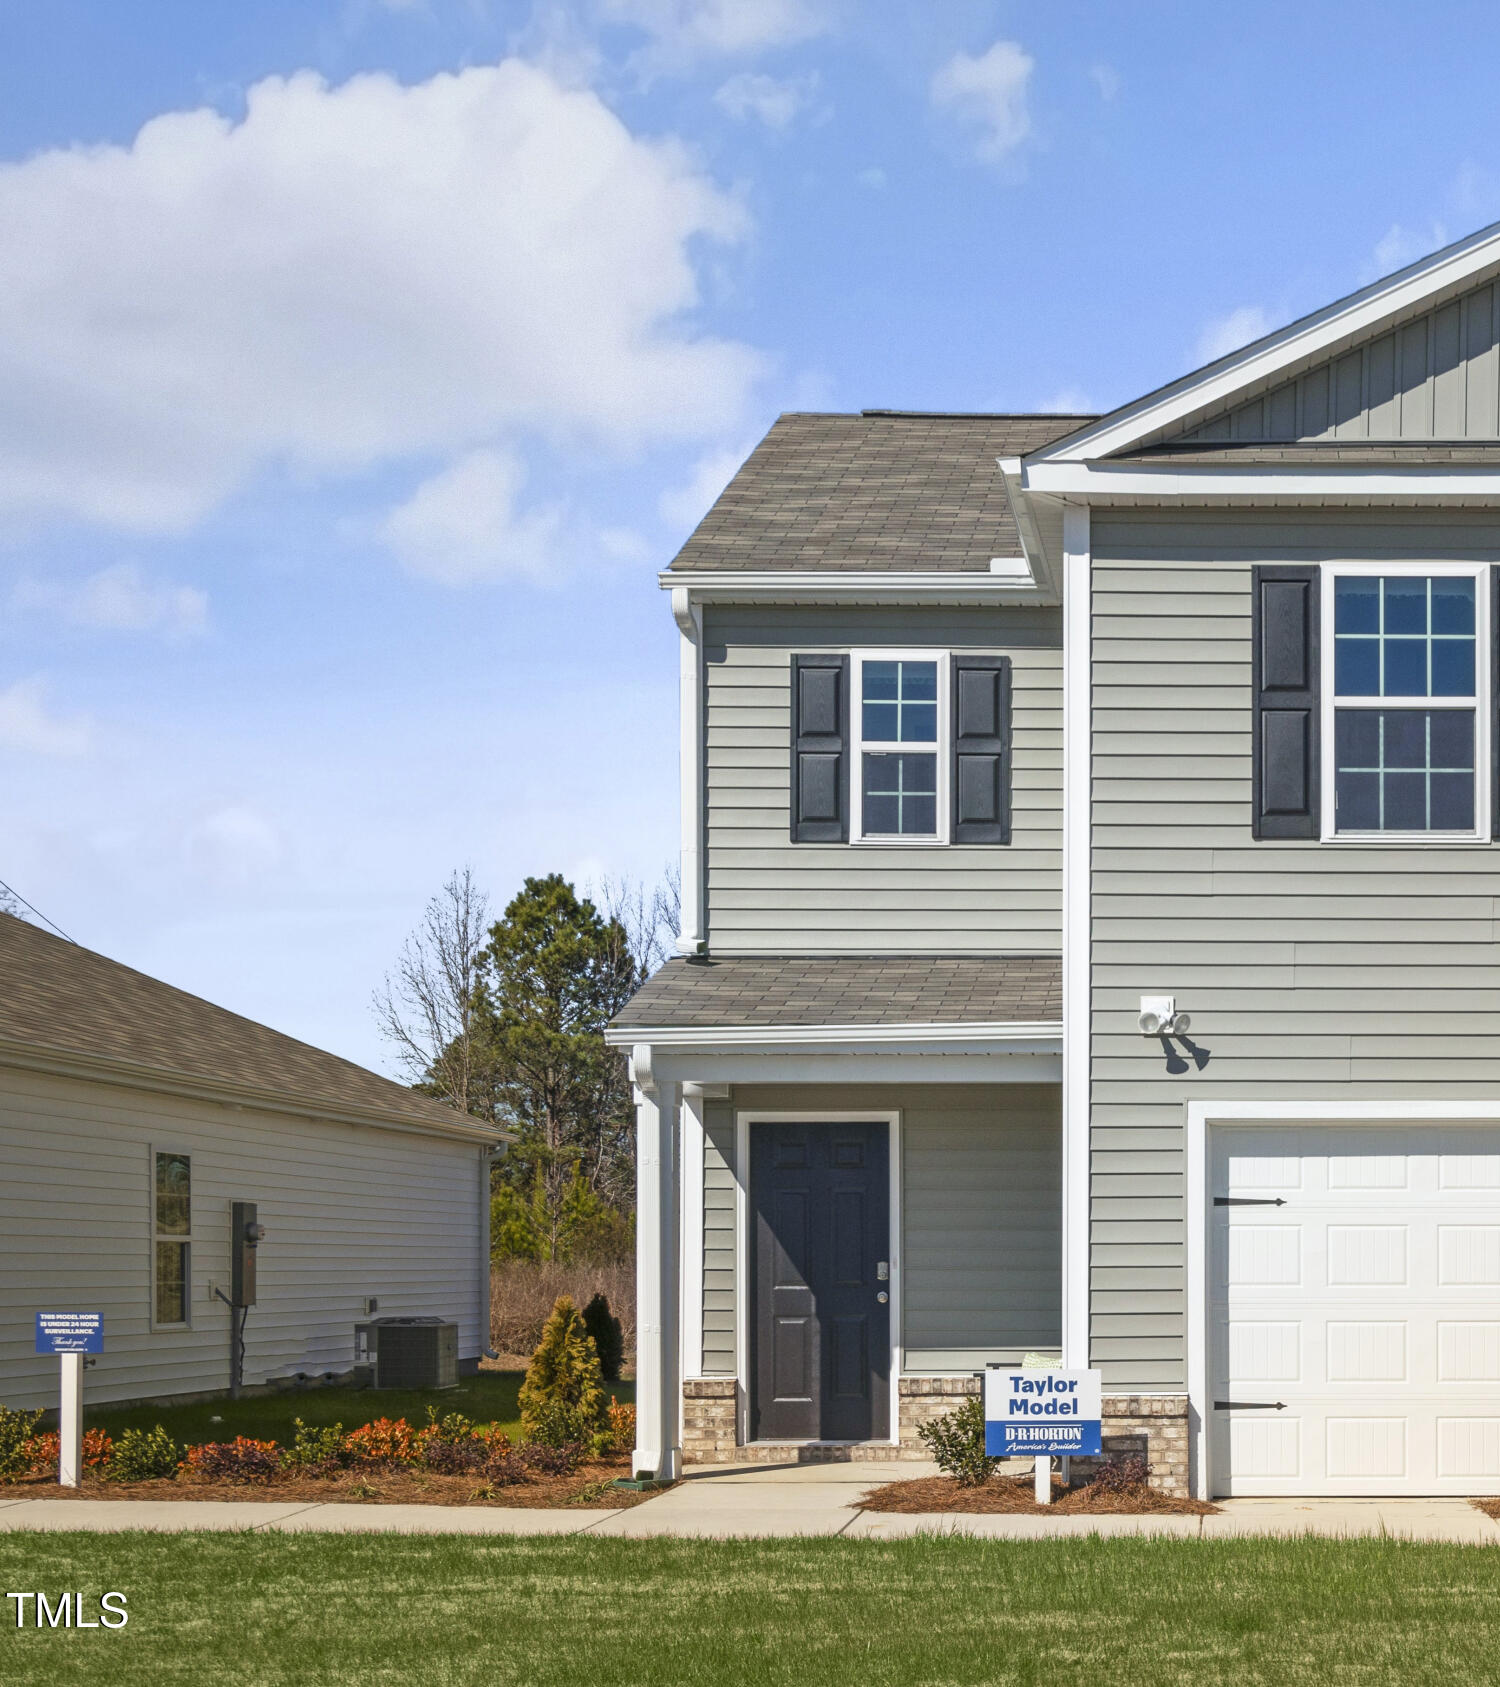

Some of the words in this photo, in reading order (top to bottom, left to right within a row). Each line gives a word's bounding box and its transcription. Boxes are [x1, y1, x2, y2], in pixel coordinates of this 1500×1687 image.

[1009, 1376, 1078, 1396] Taylor
[1009, 1398, 1078, 1415] Model
[1005, 1442, 1046, 1452] America's
[1048, 1442, 1082, 1451] Builder
